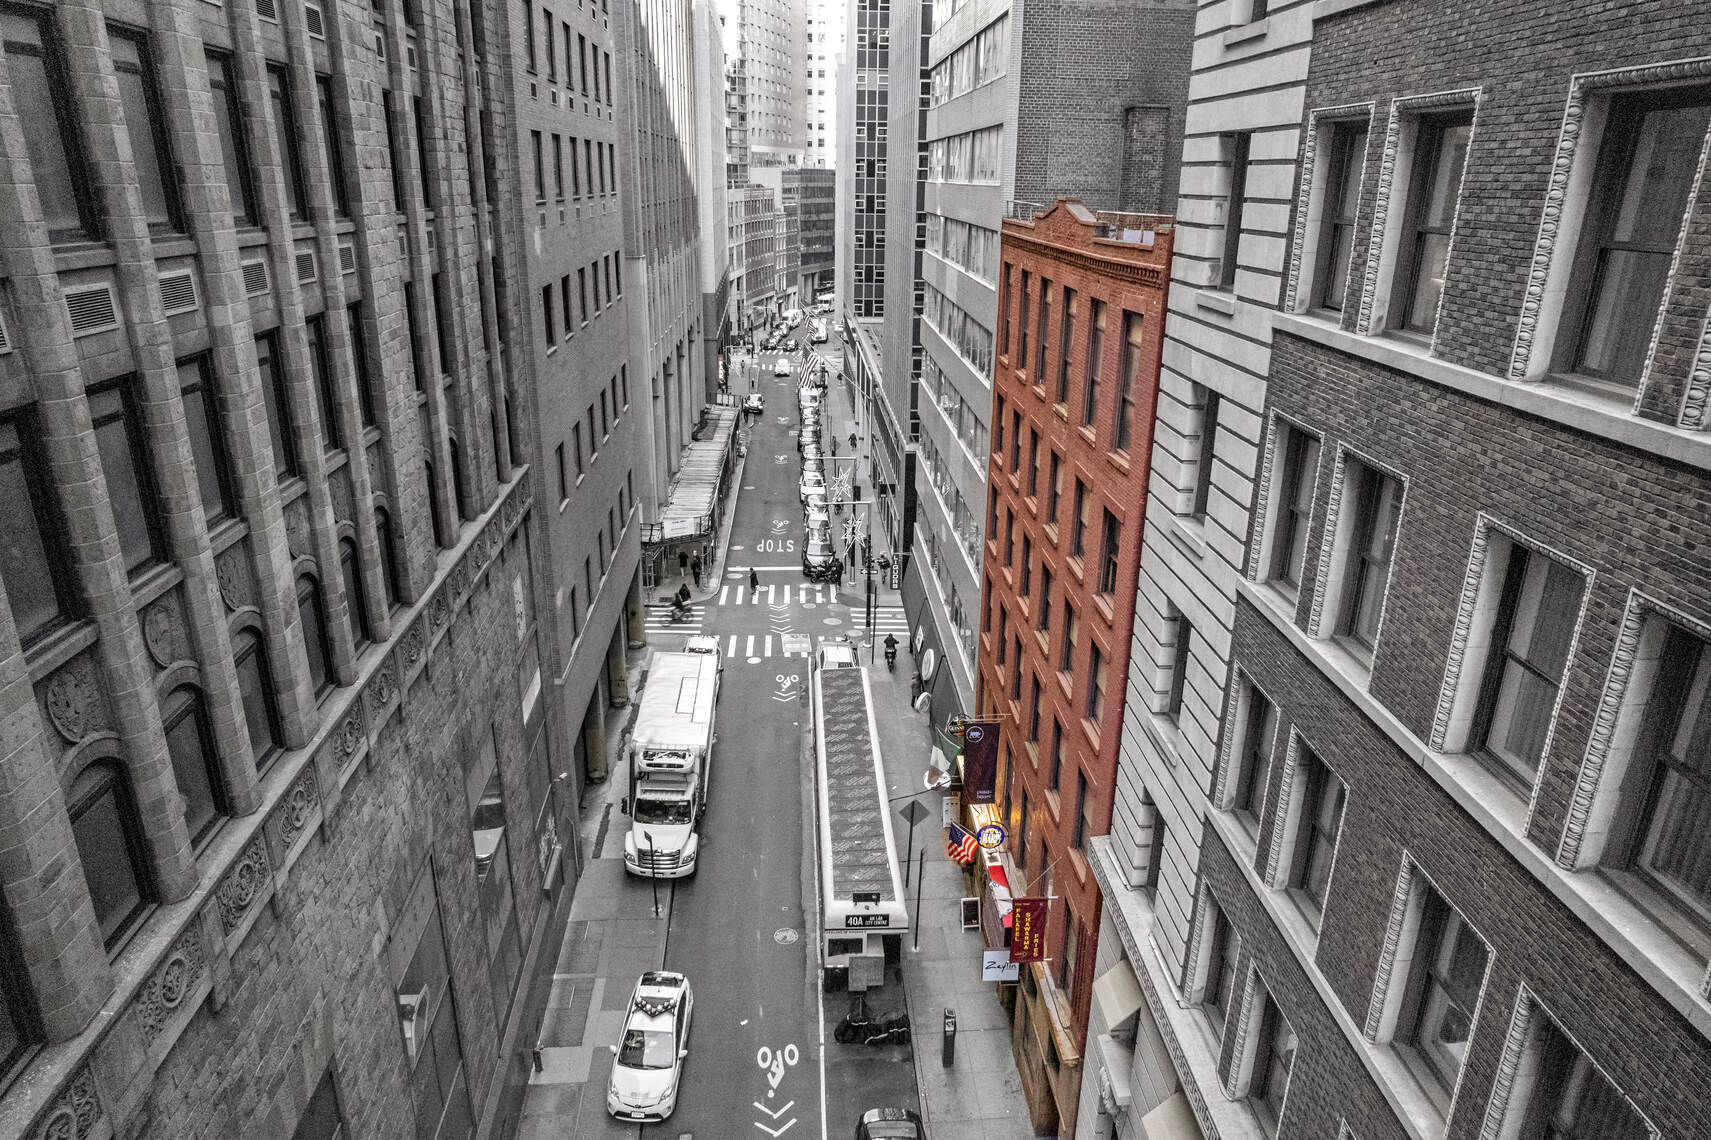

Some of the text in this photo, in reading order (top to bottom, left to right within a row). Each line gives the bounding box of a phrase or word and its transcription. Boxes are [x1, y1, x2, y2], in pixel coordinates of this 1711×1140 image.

[757, 539, 794, 552] STOP
[982, 832, 1000, 844] HARP
[847, 916, 863, 926] 40A
